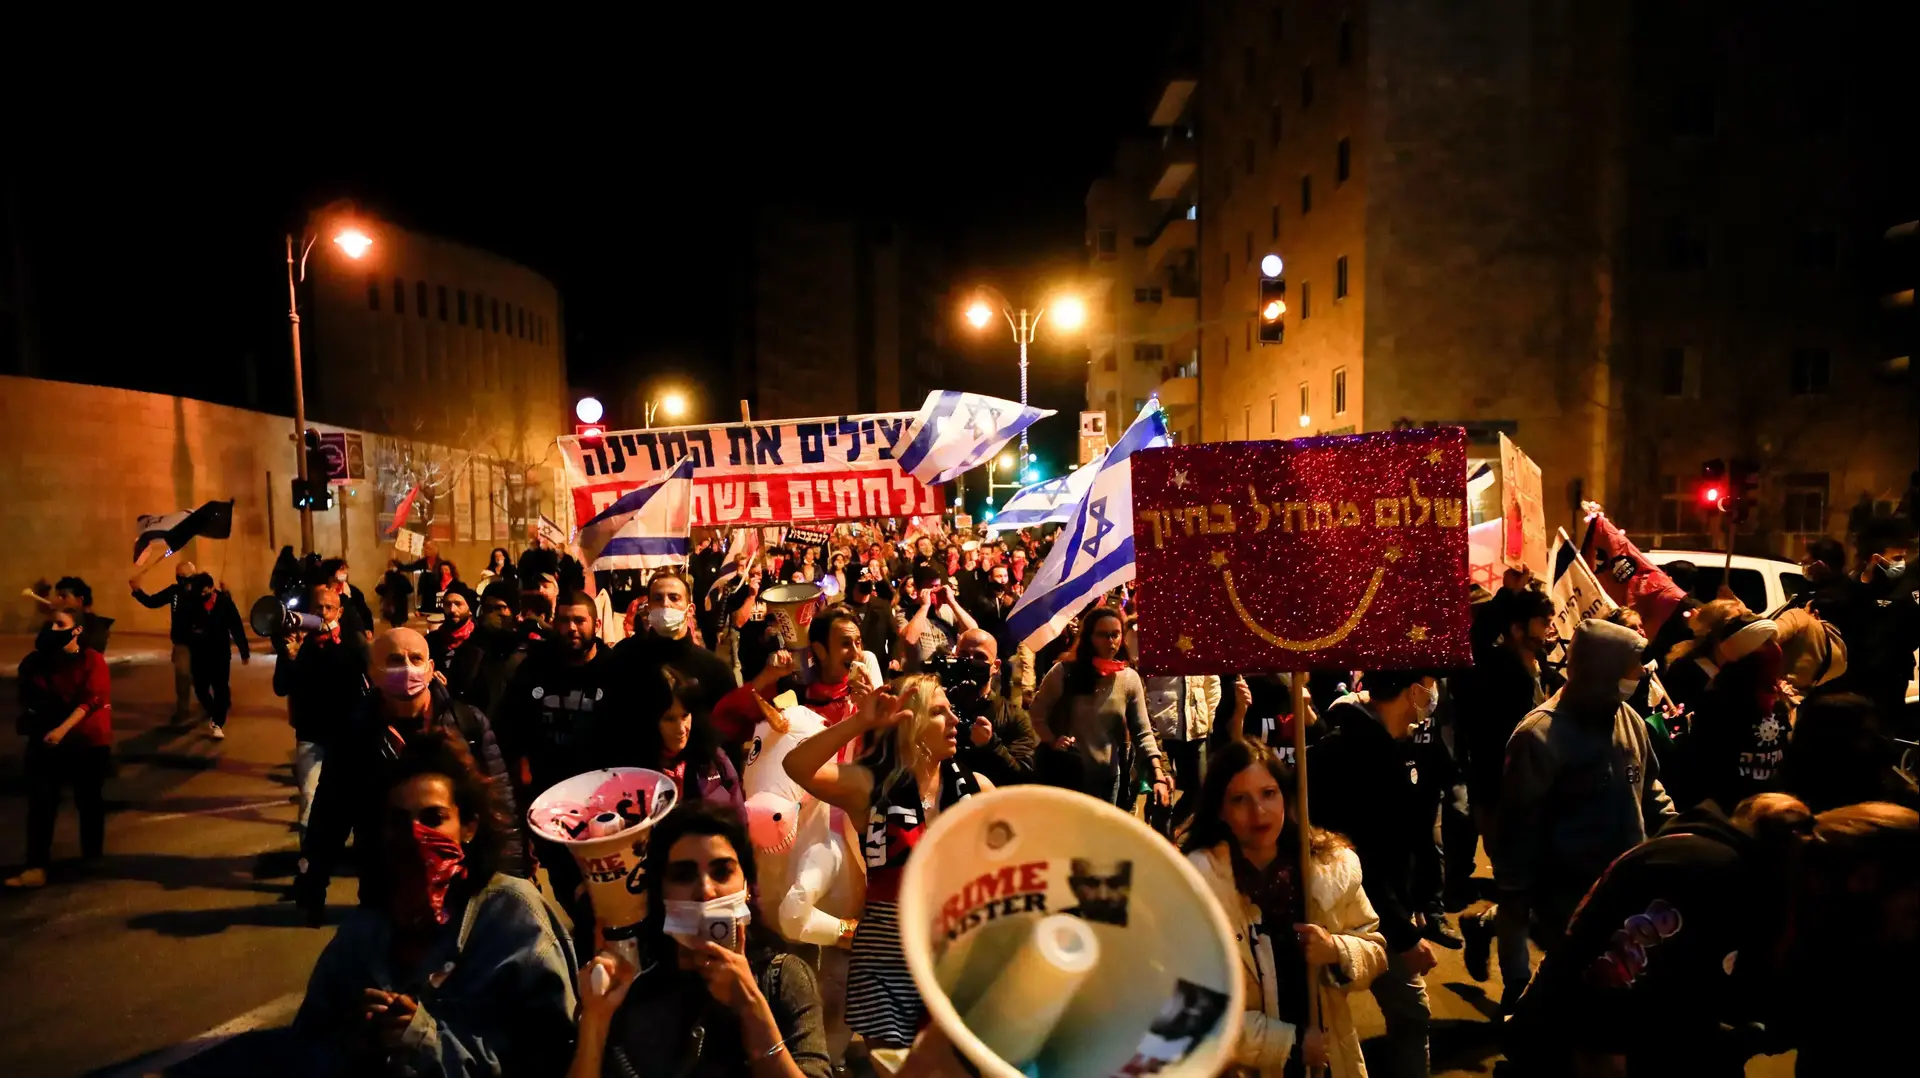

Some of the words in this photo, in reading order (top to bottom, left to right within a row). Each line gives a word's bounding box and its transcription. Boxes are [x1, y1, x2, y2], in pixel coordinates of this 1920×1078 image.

[579, 429, 715, 476] המדינה
[726, 425, 784, 466] את
[797, 416, 914, 464] צילים
[787, 467, 935, 518] נלחמים
[1247, 483, 1361, 533] מתחיל
[1373, 477, 1463, 529] שלום
[1139, 503, 1238, 549] בחיוך
[936, 861, 1048, 935] RIME
